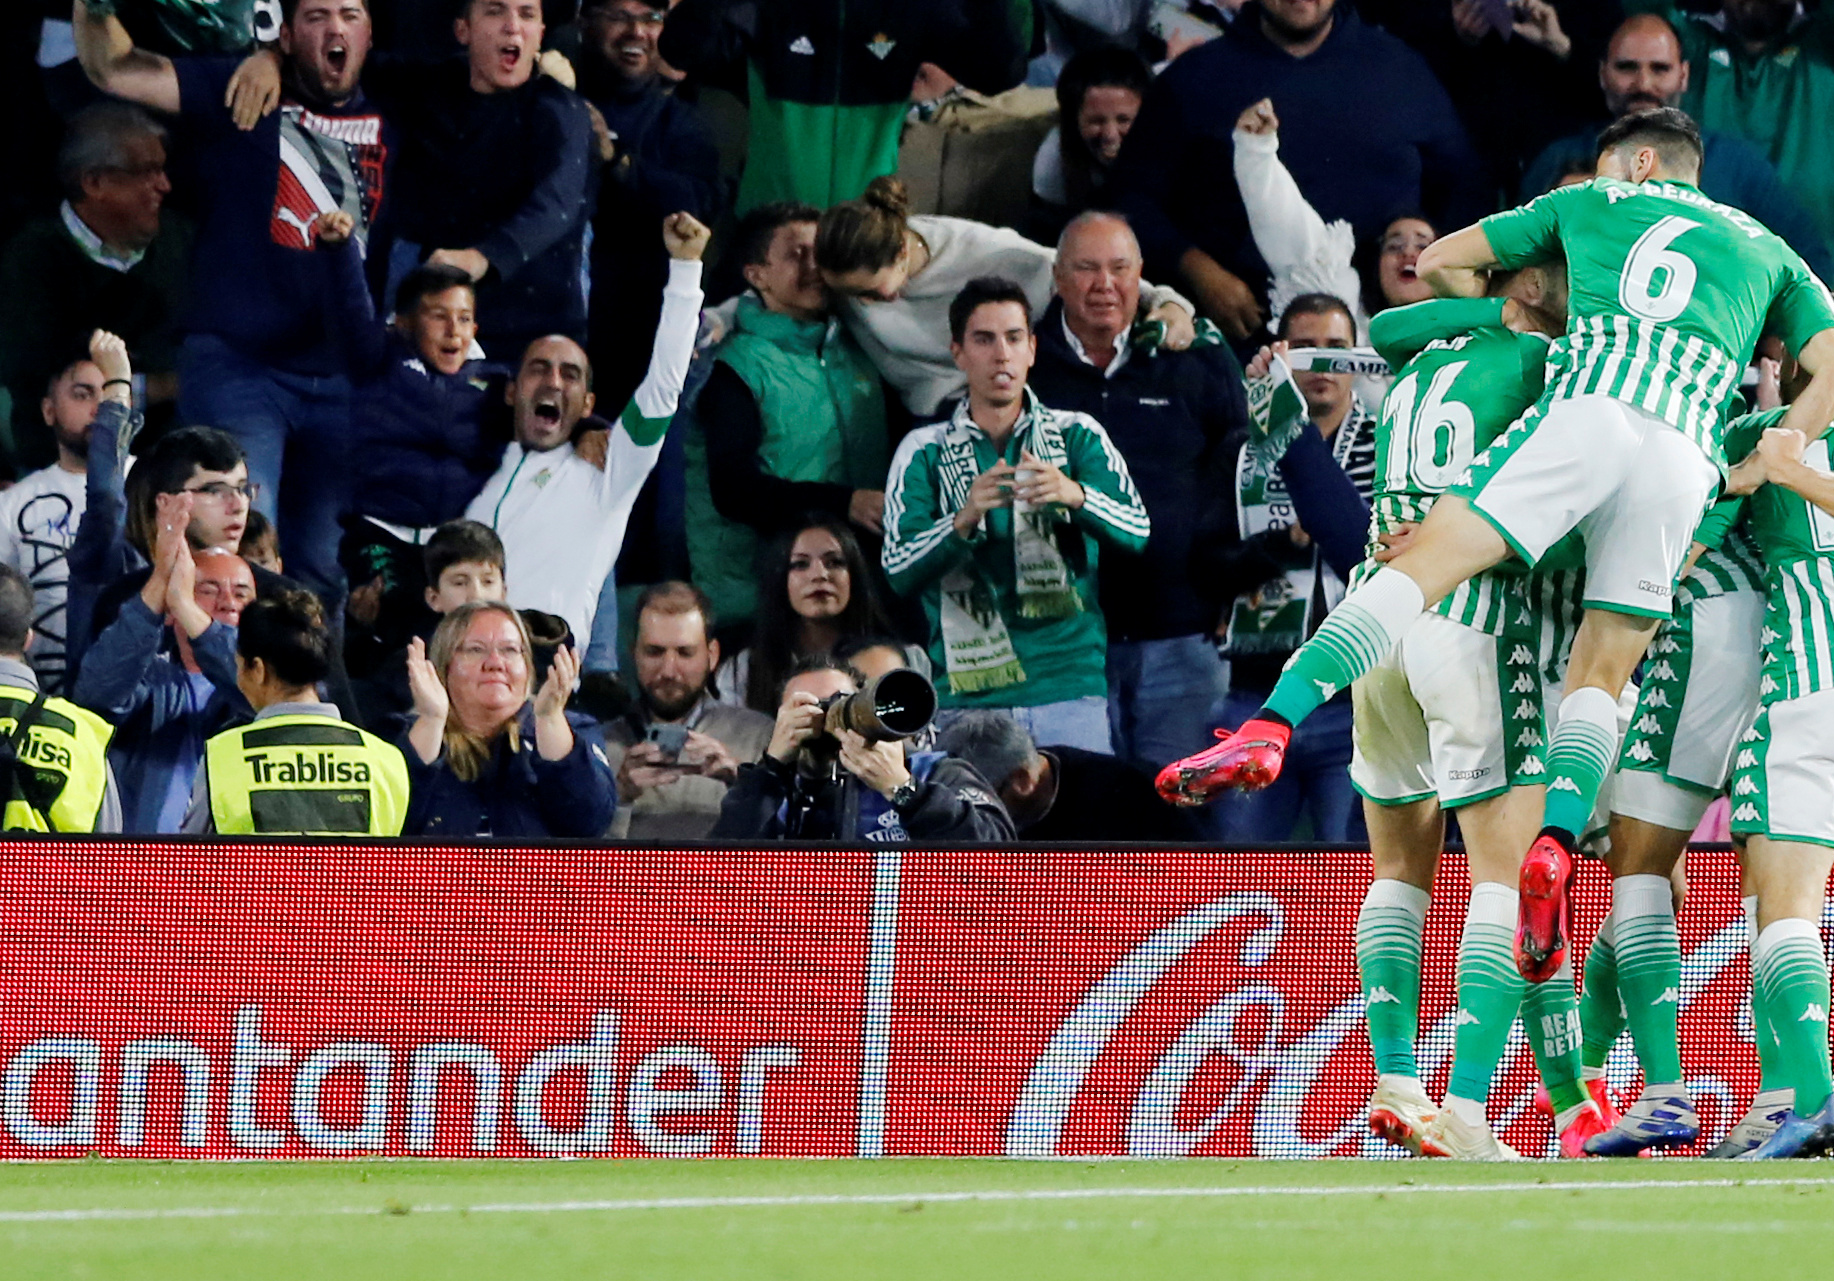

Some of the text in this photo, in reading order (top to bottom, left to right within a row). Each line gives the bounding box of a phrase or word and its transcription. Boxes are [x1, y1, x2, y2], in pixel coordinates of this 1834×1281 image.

[1618, 215, 1703, 322] 6
[1382, 360, 1476, 493] 16
[245, 753, 370, 783] Trablisa
[2, 1004, 802, 1153] antander
